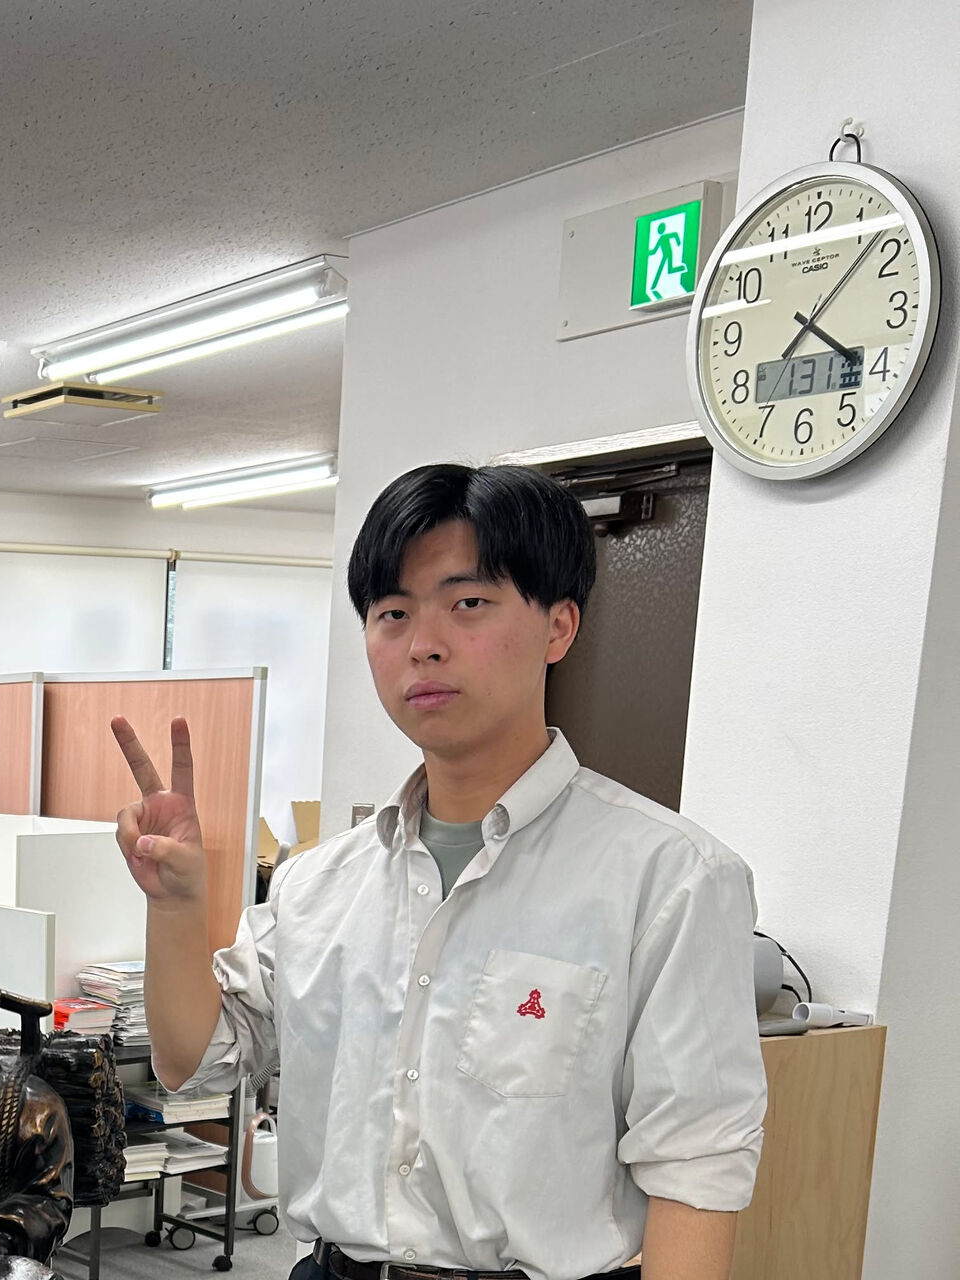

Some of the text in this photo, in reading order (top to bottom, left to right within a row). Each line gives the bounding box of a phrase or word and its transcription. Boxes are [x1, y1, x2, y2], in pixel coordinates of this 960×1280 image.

[805, 201, 833, 233] 12
[802, 262, 829, 274] CASIO
[878, 238, 902, 278] 2
[736, 268, 762, 304] 10
[886, 291, 908, 329] 3
[723, 321, 742, 357] 9
[869, 347, 891, 382] 4
[732, 369, 750, 404] 8
[757, 404, 776, 438] 7
[793, 408, 814, 444] 6
[836, 392, 857, 428] 5
